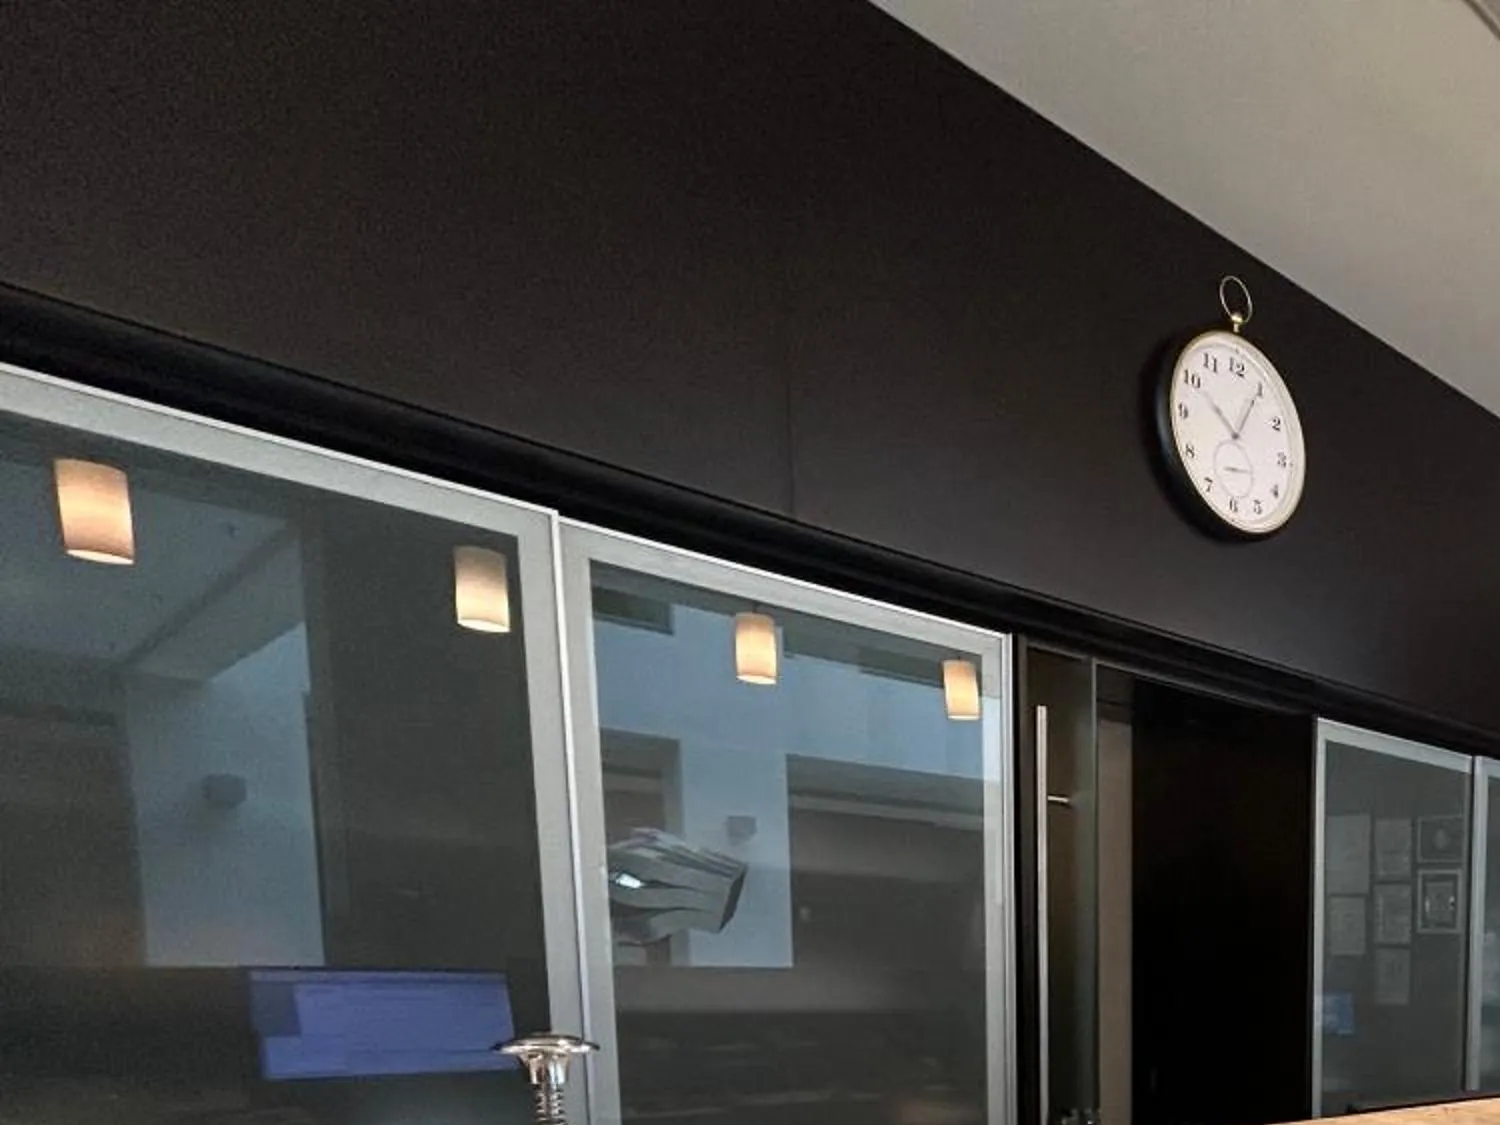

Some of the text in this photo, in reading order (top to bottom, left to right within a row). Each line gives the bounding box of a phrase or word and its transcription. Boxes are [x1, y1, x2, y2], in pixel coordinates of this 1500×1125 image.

[1203, 353, 1218, 374] 11
[1228, 357, 1245, 378] 12
[1183, 369, 1201, 389] 10
[1178, 403, 1189, 418] 9
[1272, 416, 1281, 431] 2
[1204, 477, 1214, 493] 7
